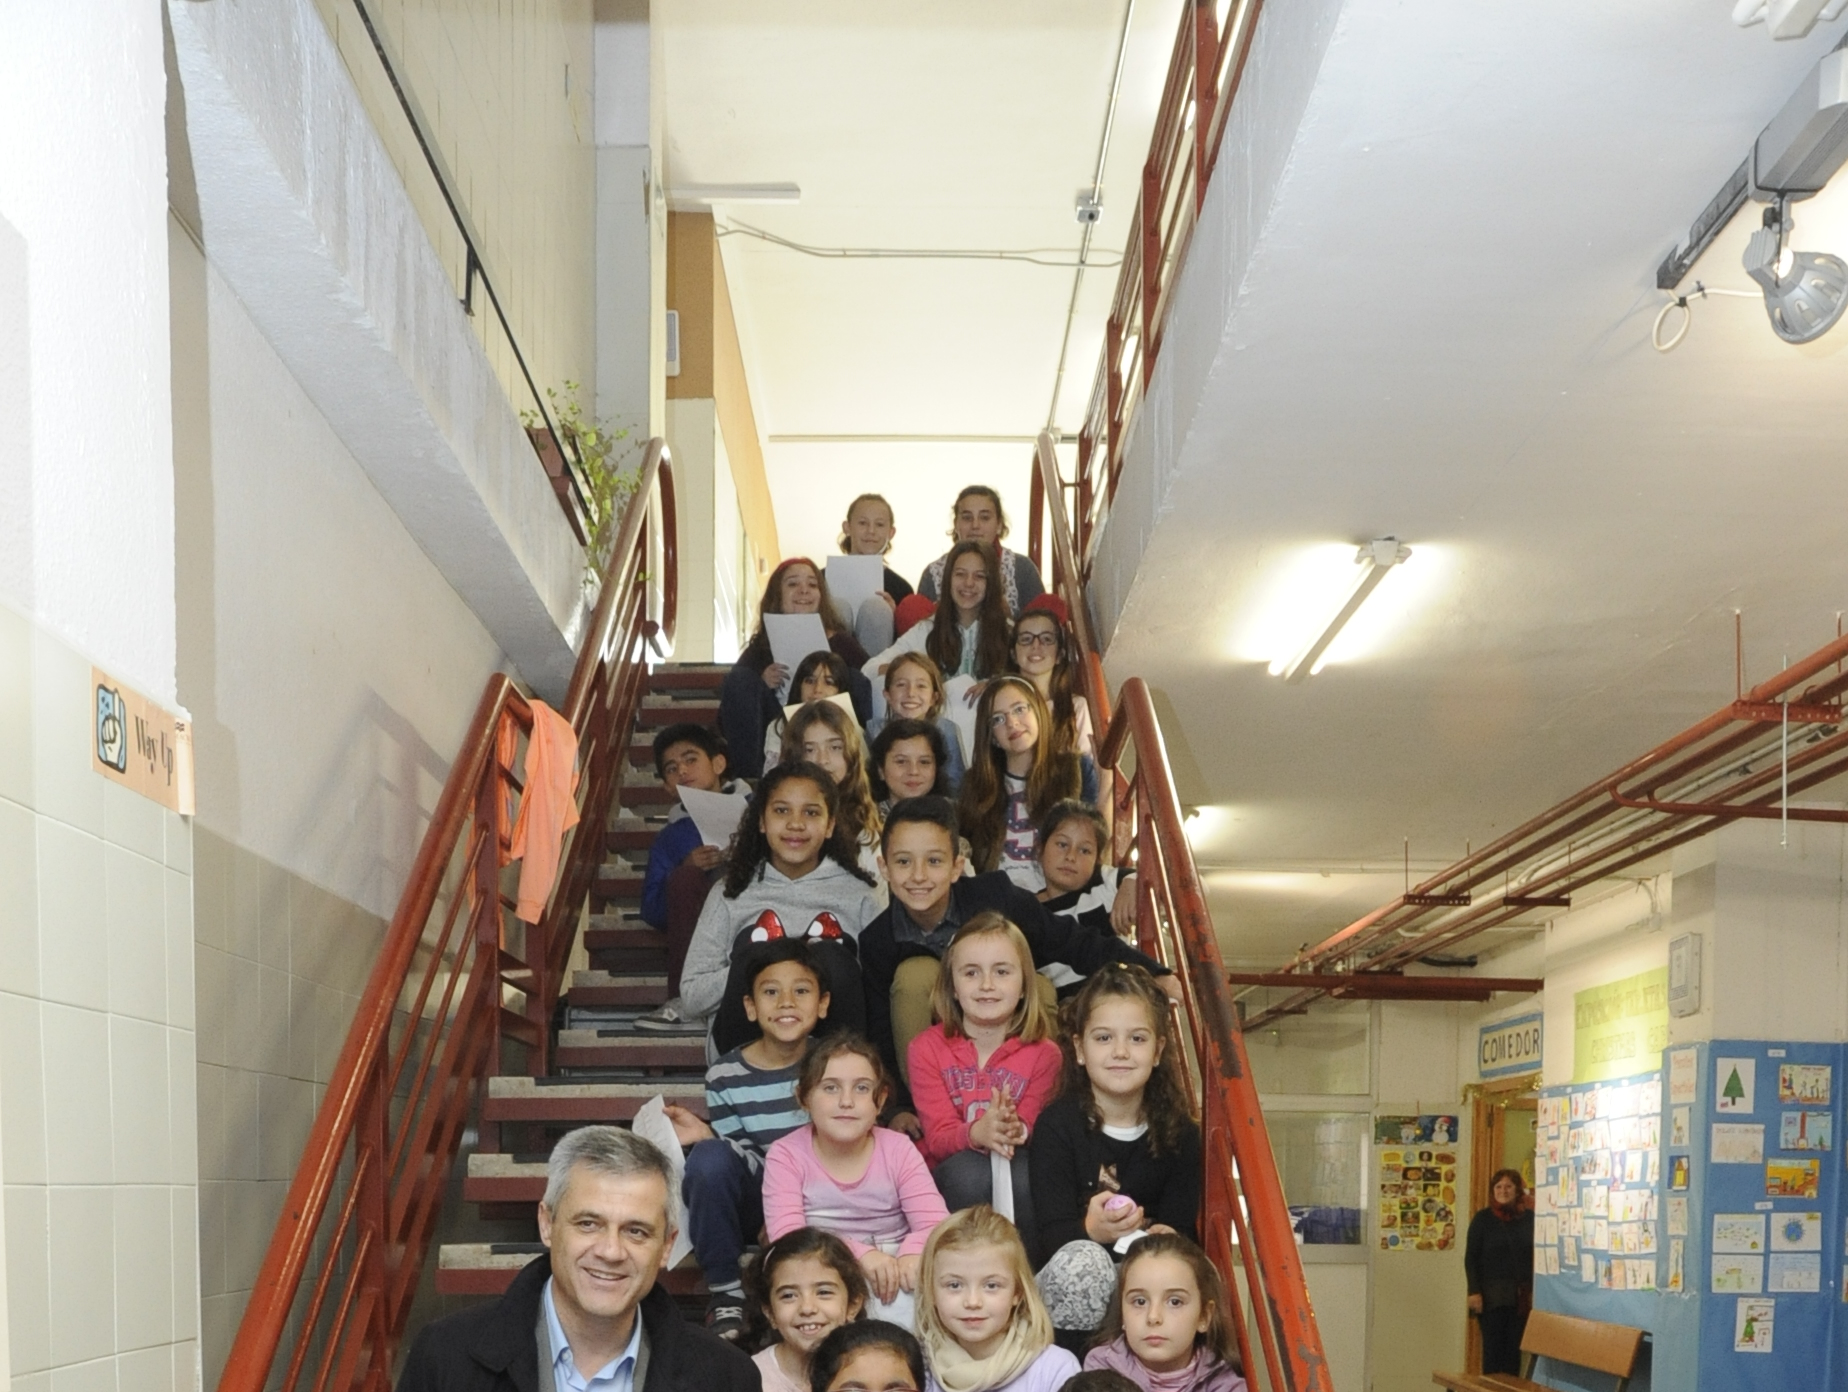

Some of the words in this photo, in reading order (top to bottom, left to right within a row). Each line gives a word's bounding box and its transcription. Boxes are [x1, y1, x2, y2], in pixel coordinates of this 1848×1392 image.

[134, 714, 158, 775] Way
[161, 730, 173, 786] Up
[1482, 1028, 1540, 1064] COMEDOR
